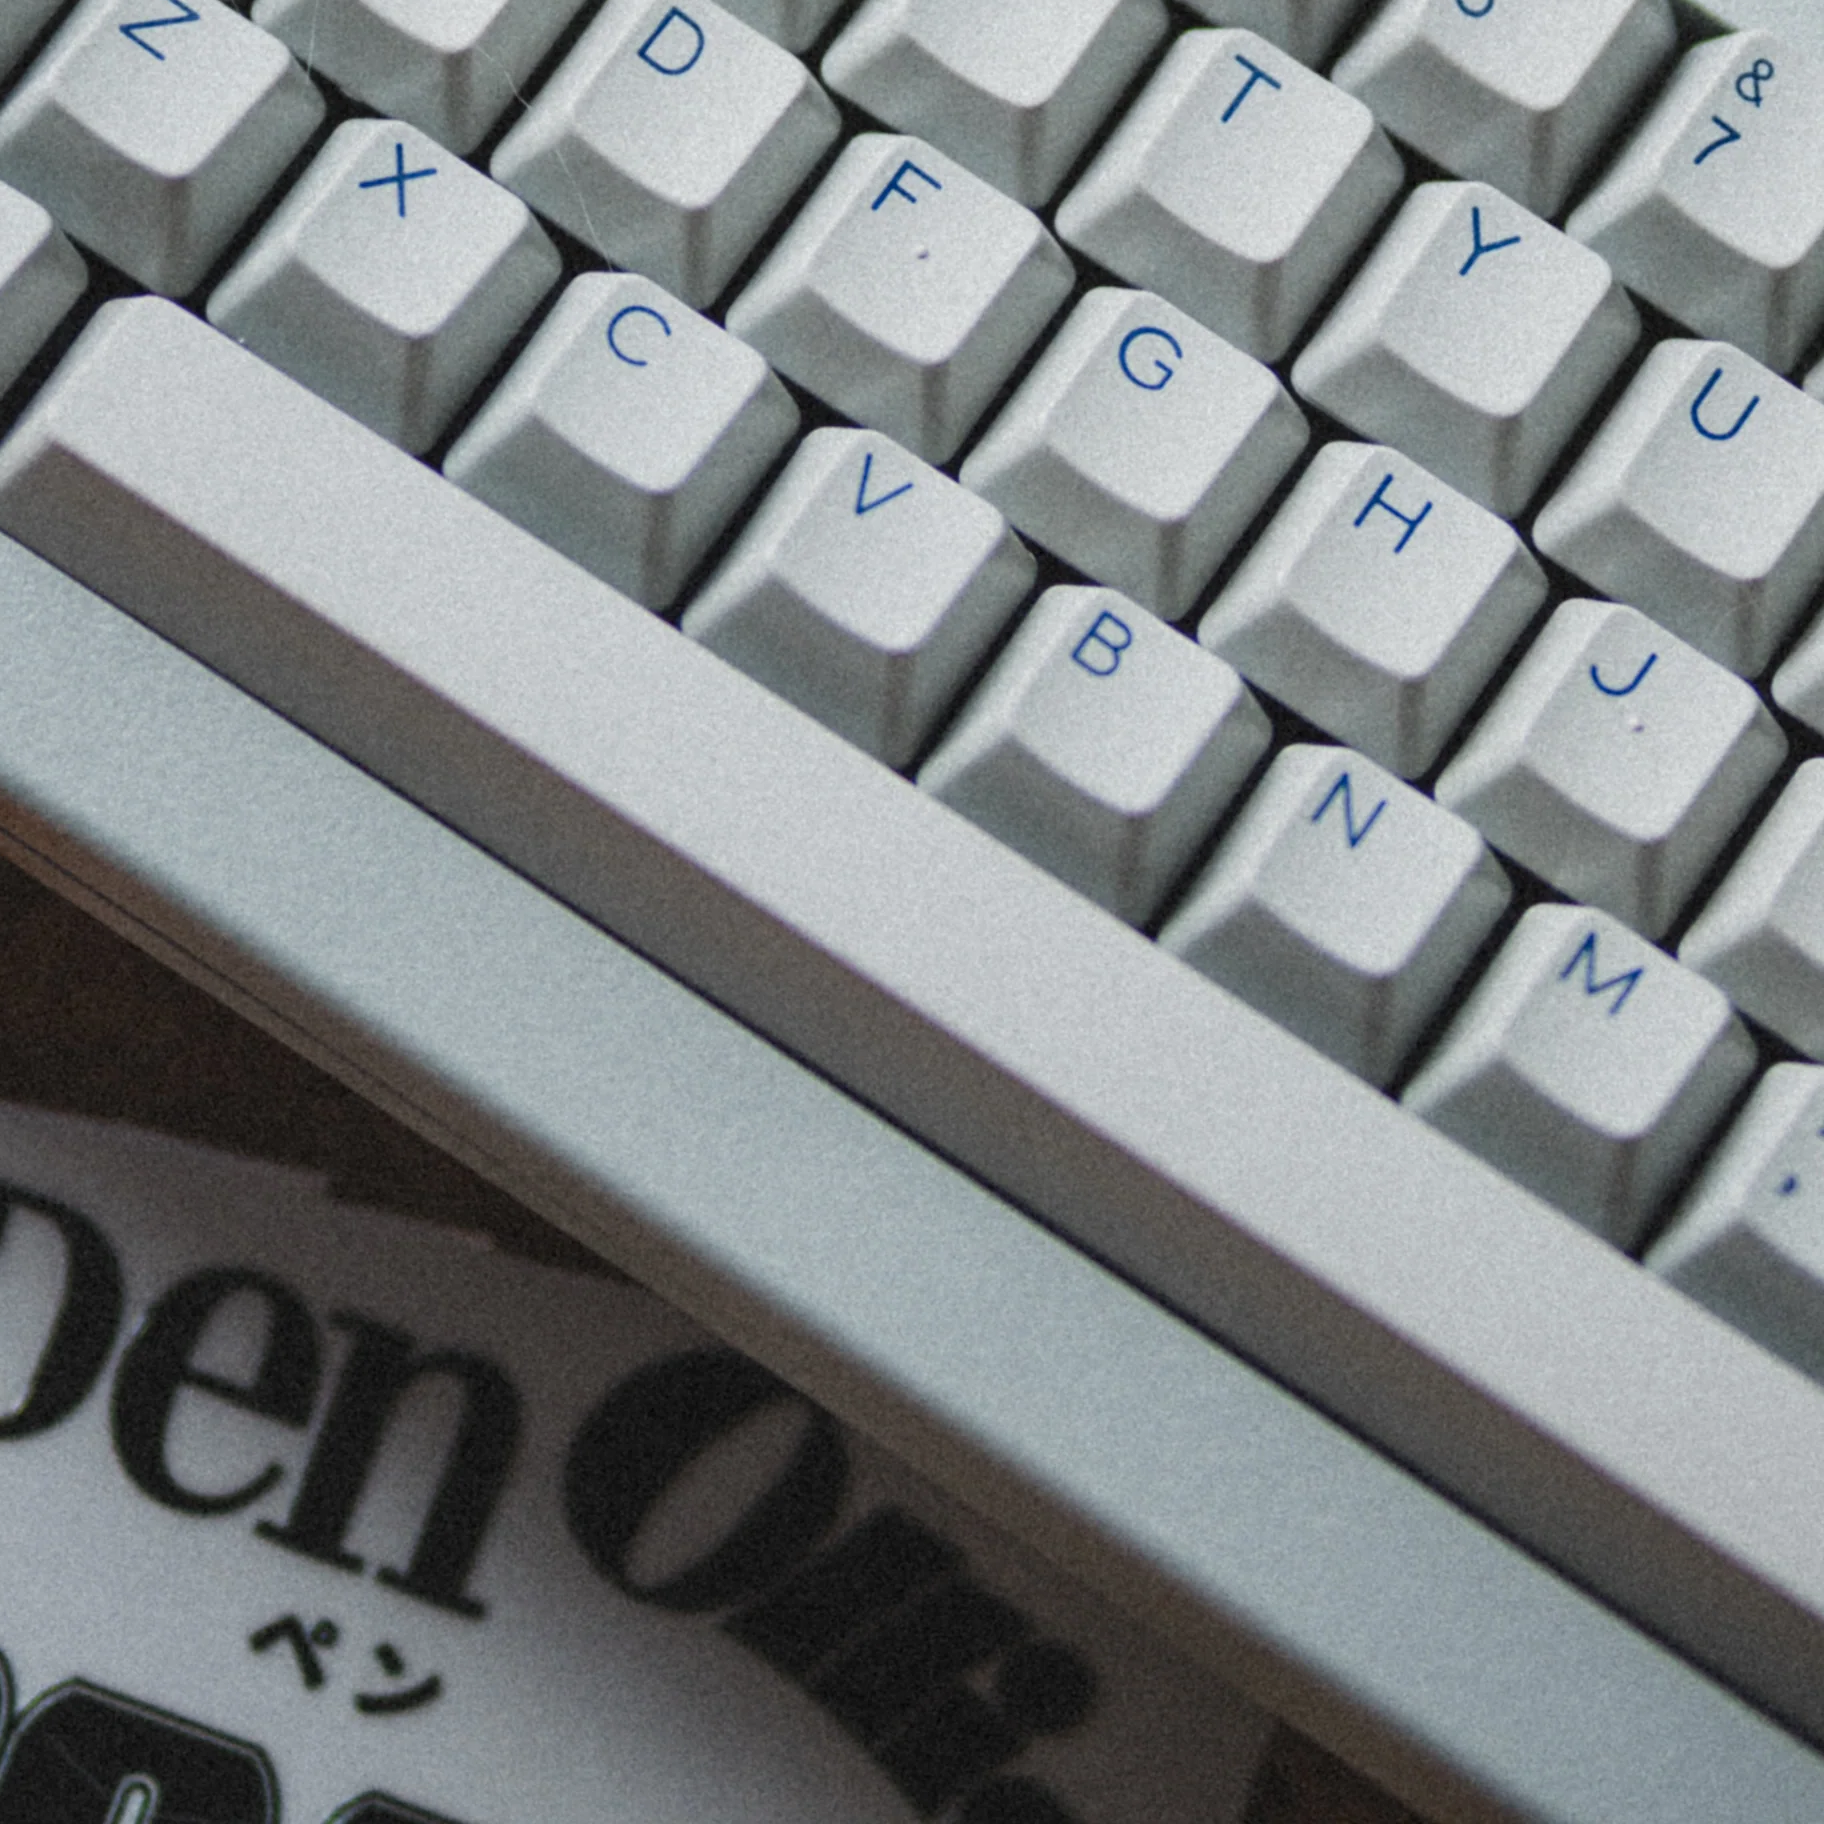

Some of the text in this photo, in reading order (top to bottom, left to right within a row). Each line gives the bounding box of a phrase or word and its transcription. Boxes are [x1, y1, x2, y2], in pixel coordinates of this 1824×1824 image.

[636, 6, 705, 76] D
[1221, 54, 1281, 123] T
[1735, 58, 1774, 108] &
[1694, 115, 1741, 165] 7
[358, 143, 437, 217] X
[871, 160, 941, 211] F
[1459, 206, 1520, 276] Y
[606, 305, 671, 367] C
[1118, 326, 1182, 390] G
[1690, 368, 1760, 441] U
[854, 453, 913, 516] V
[1353, 473, 1433, 553] H
[1070, 610, 1133, 677] B
[1589, 653, 1657, 697] J
[1310, 772, 1386, 848] N
[1559, 931, 1644, 1014] M
[246, 1612, 446, 1717] ペン
